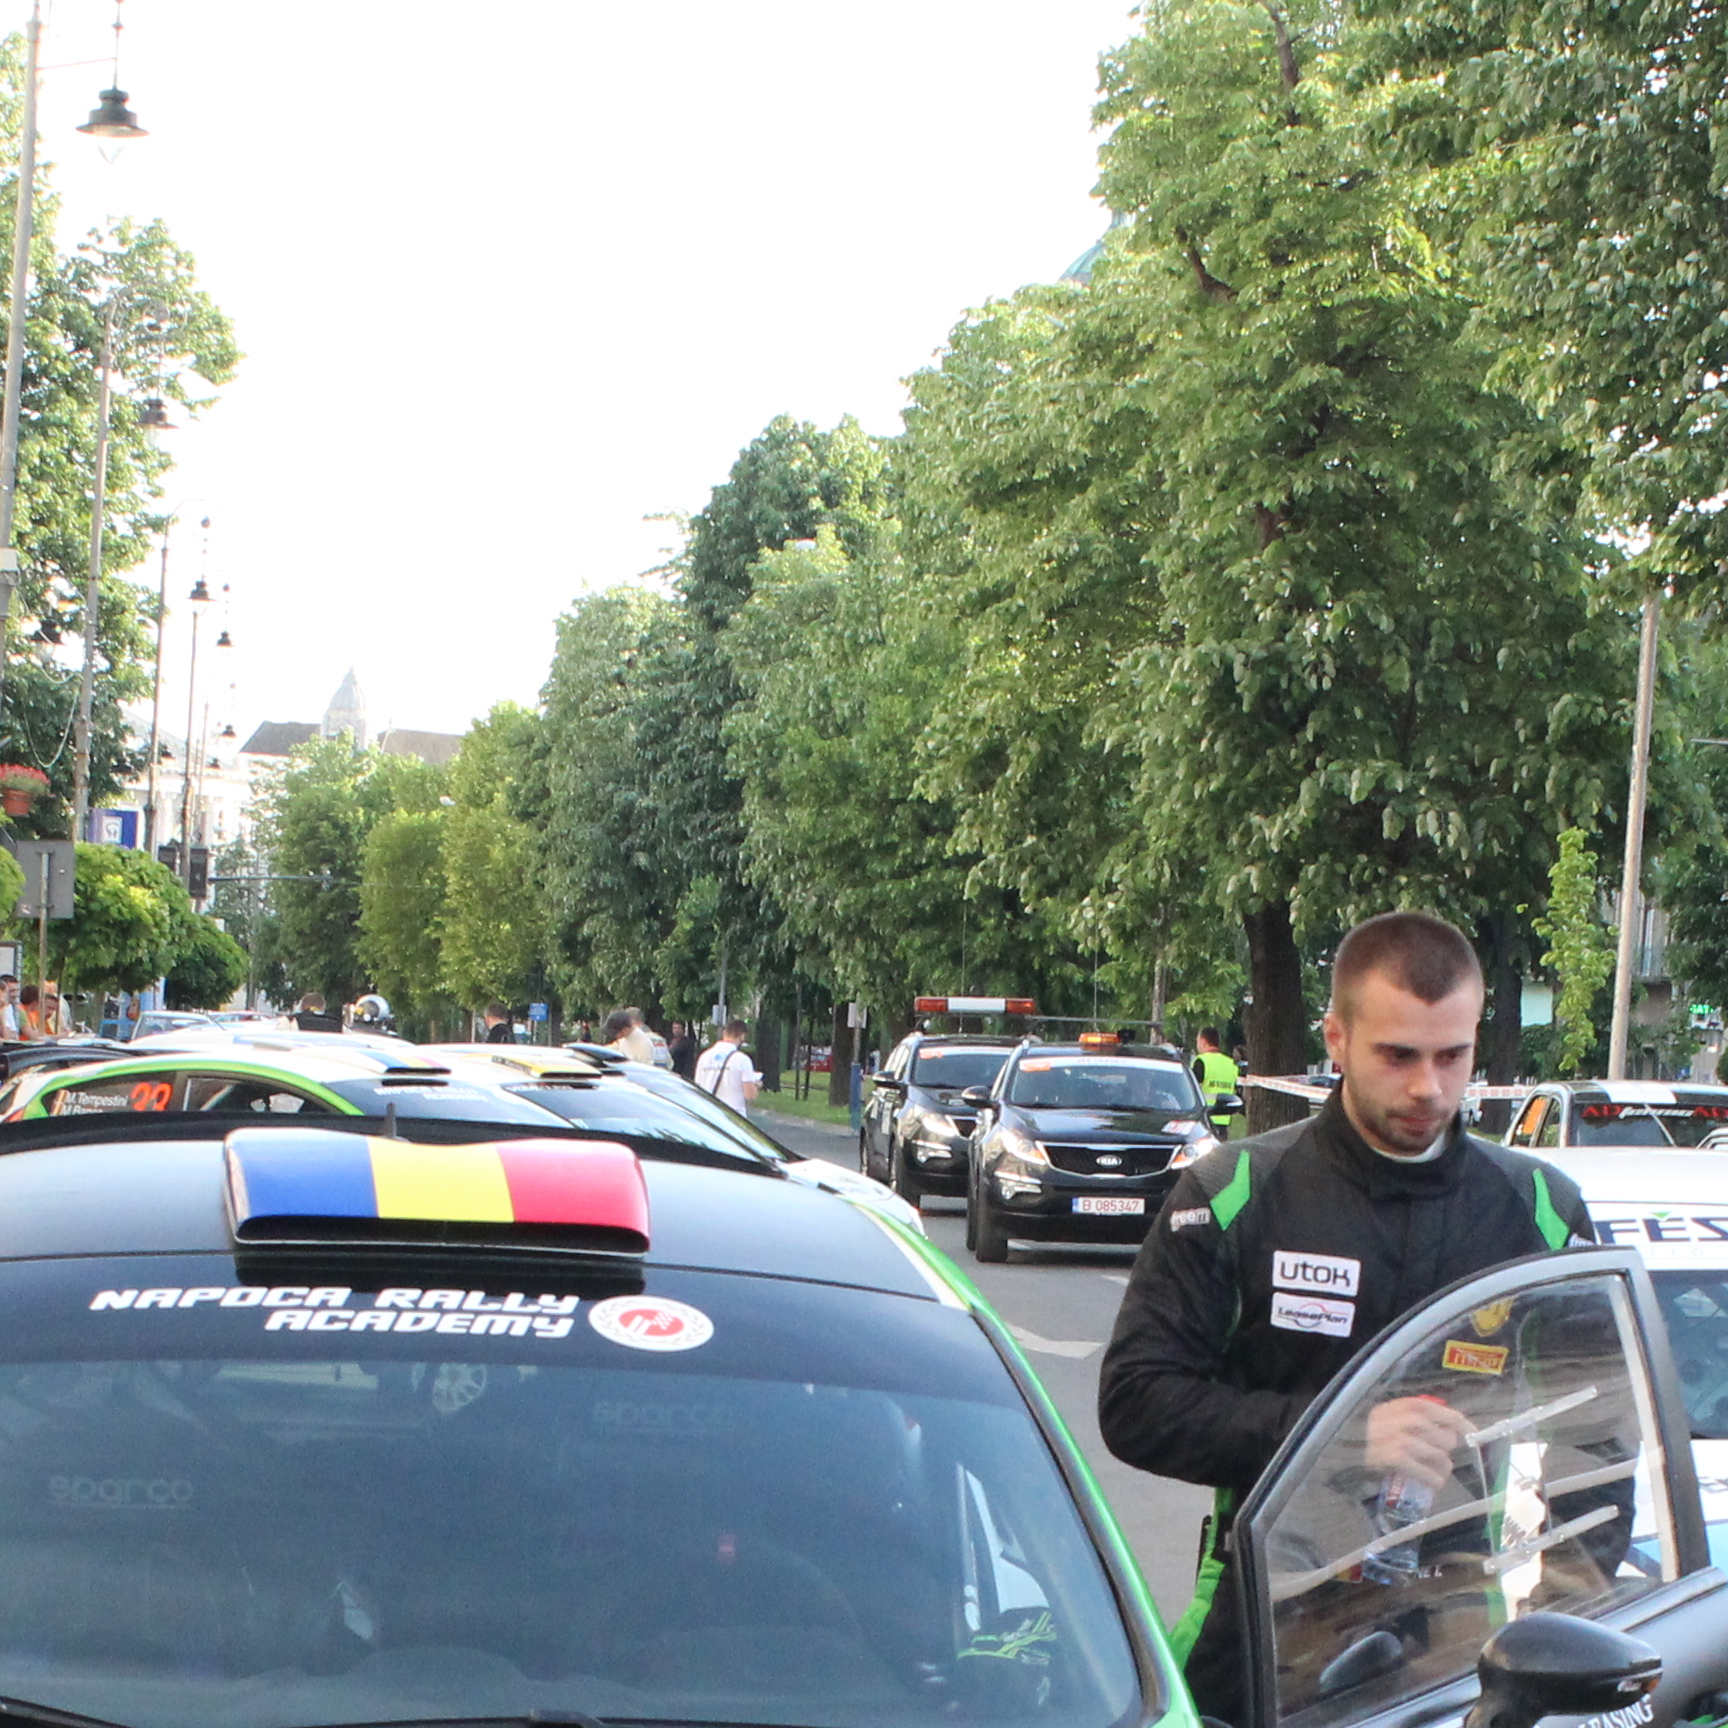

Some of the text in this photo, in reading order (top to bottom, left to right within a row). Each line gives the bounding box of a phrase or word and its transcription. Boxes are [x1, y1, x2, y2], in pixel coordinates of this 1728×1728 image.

[1100, 1156, 1119, 1166] KIA
[1083, 1198, 1139, 1213] B 085347
[90, 1286, 581, 1315] NAPOCA RALLY
[264, 1309, 574, 1338] ACADEMY
[1278, 1306, 1348, 1325] LeasePlan
